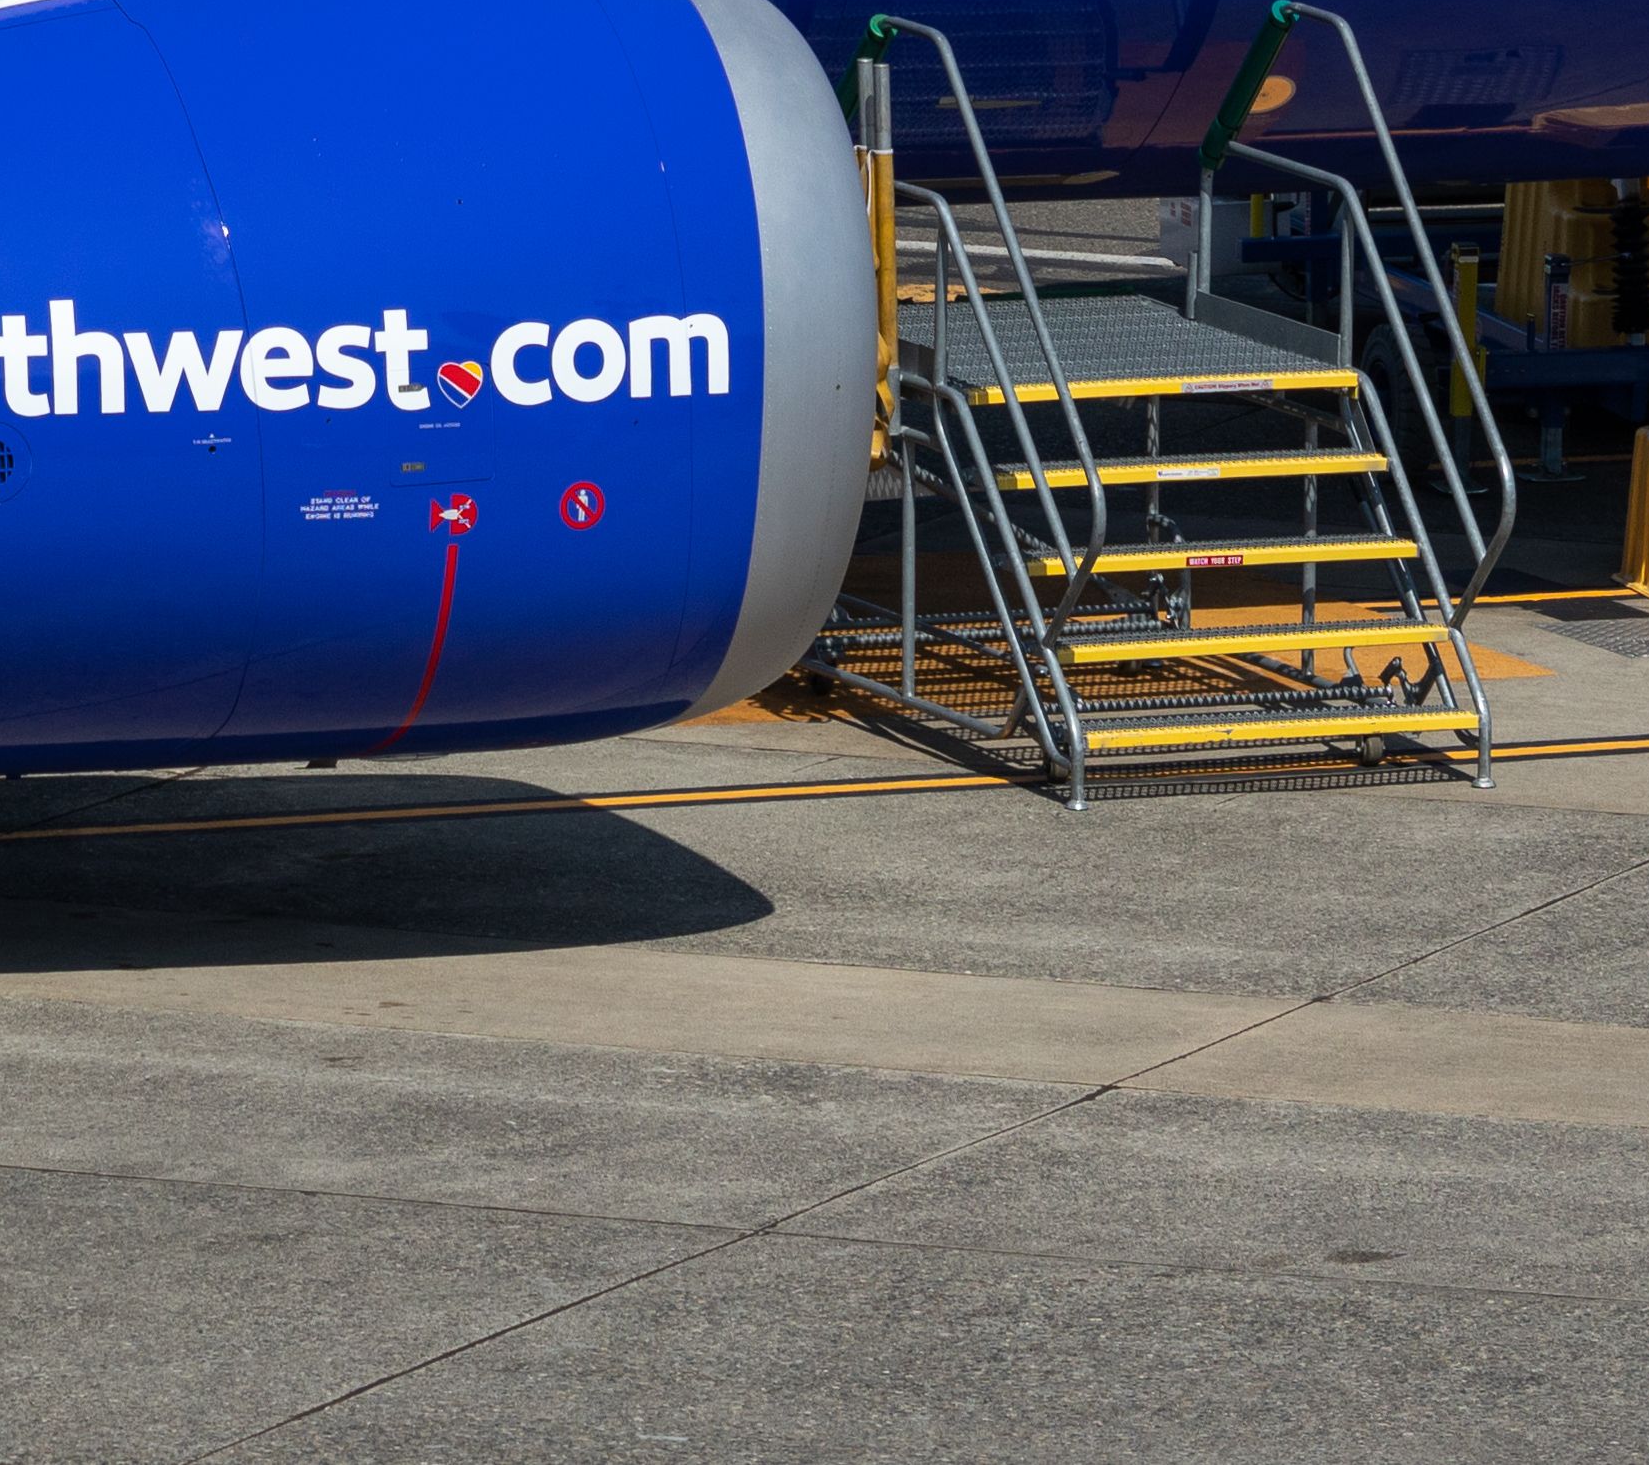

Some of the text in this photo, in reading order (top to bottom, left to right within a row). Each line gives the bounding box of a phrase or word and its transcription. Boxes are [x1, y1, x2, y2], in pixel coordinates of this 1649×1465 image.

[335, 496, 359, 504] CLEAR
[1188, 556, 1242, 566] WATCH YOUR STEP
